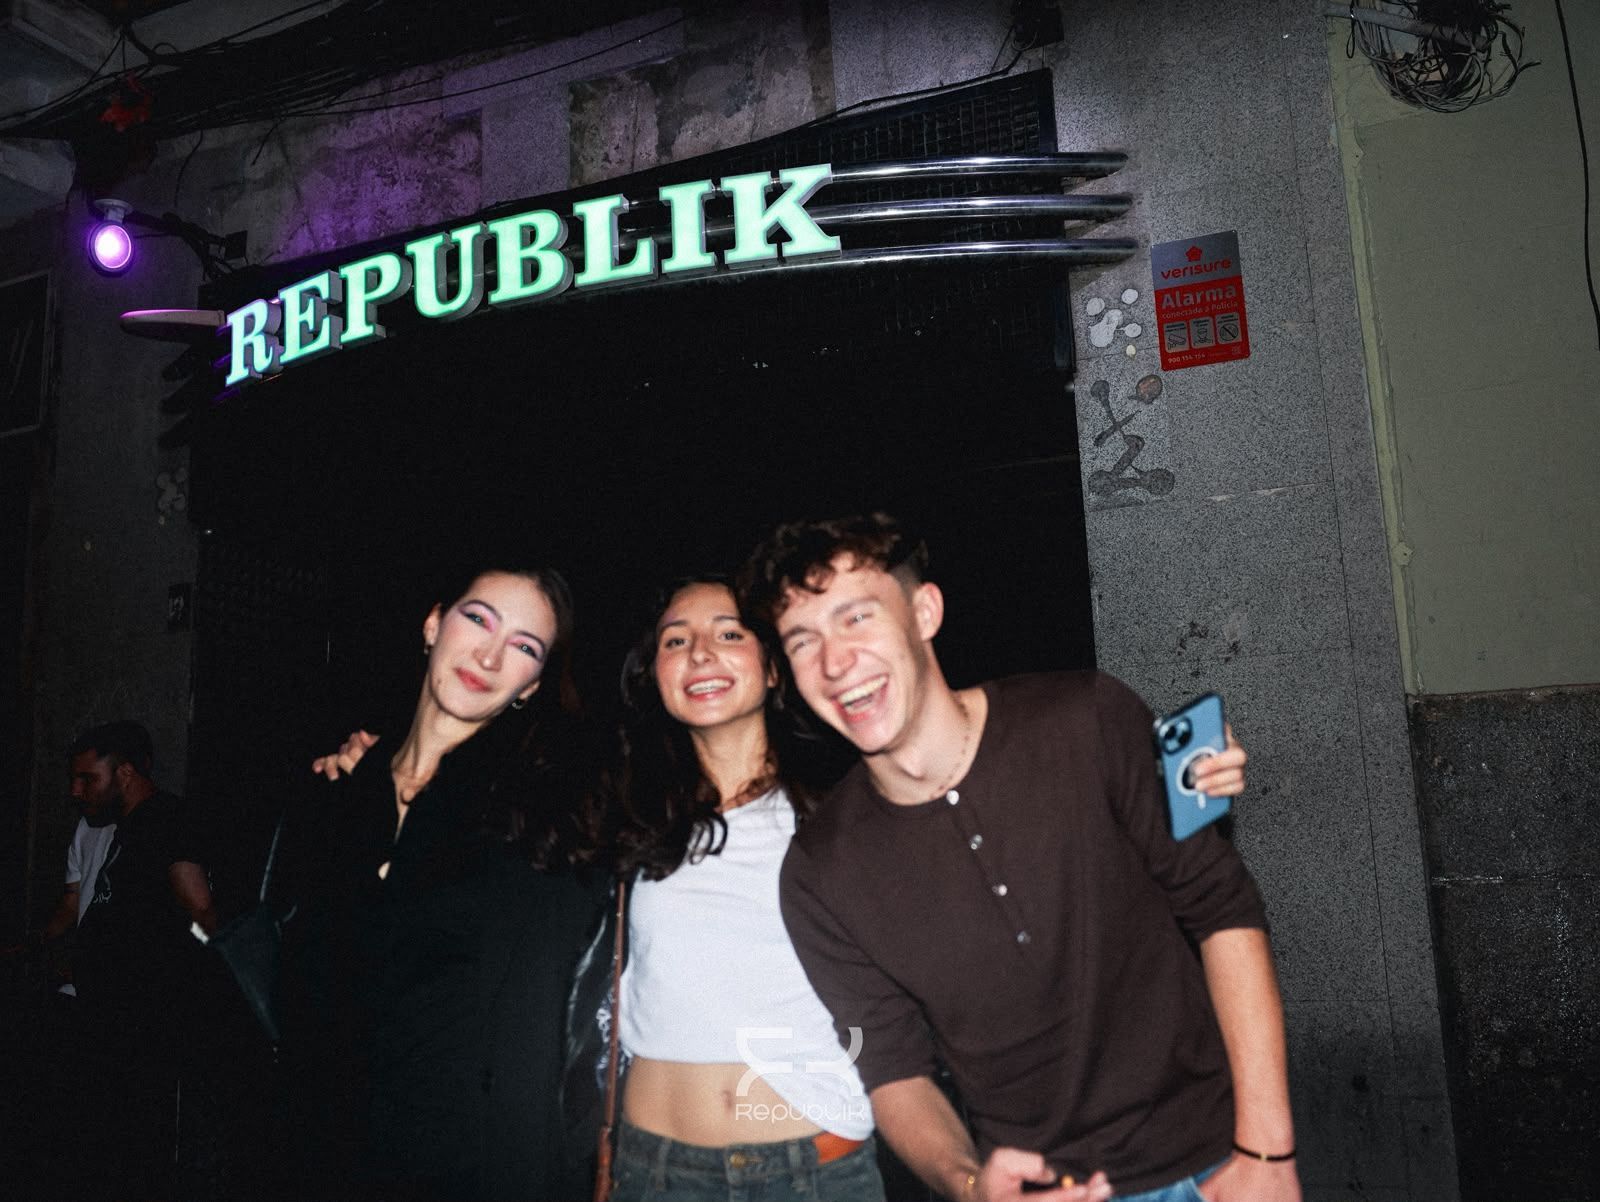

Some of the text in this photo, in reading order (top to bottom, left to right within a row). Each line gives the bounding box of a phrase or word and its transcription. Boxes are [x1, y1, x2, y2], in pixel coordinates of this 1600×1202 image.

[224, 162, 843, 387] REPUBLIK
[1161, 259, 1232, 280] verisure
[1162, 284, 1237, 309] Alarma
